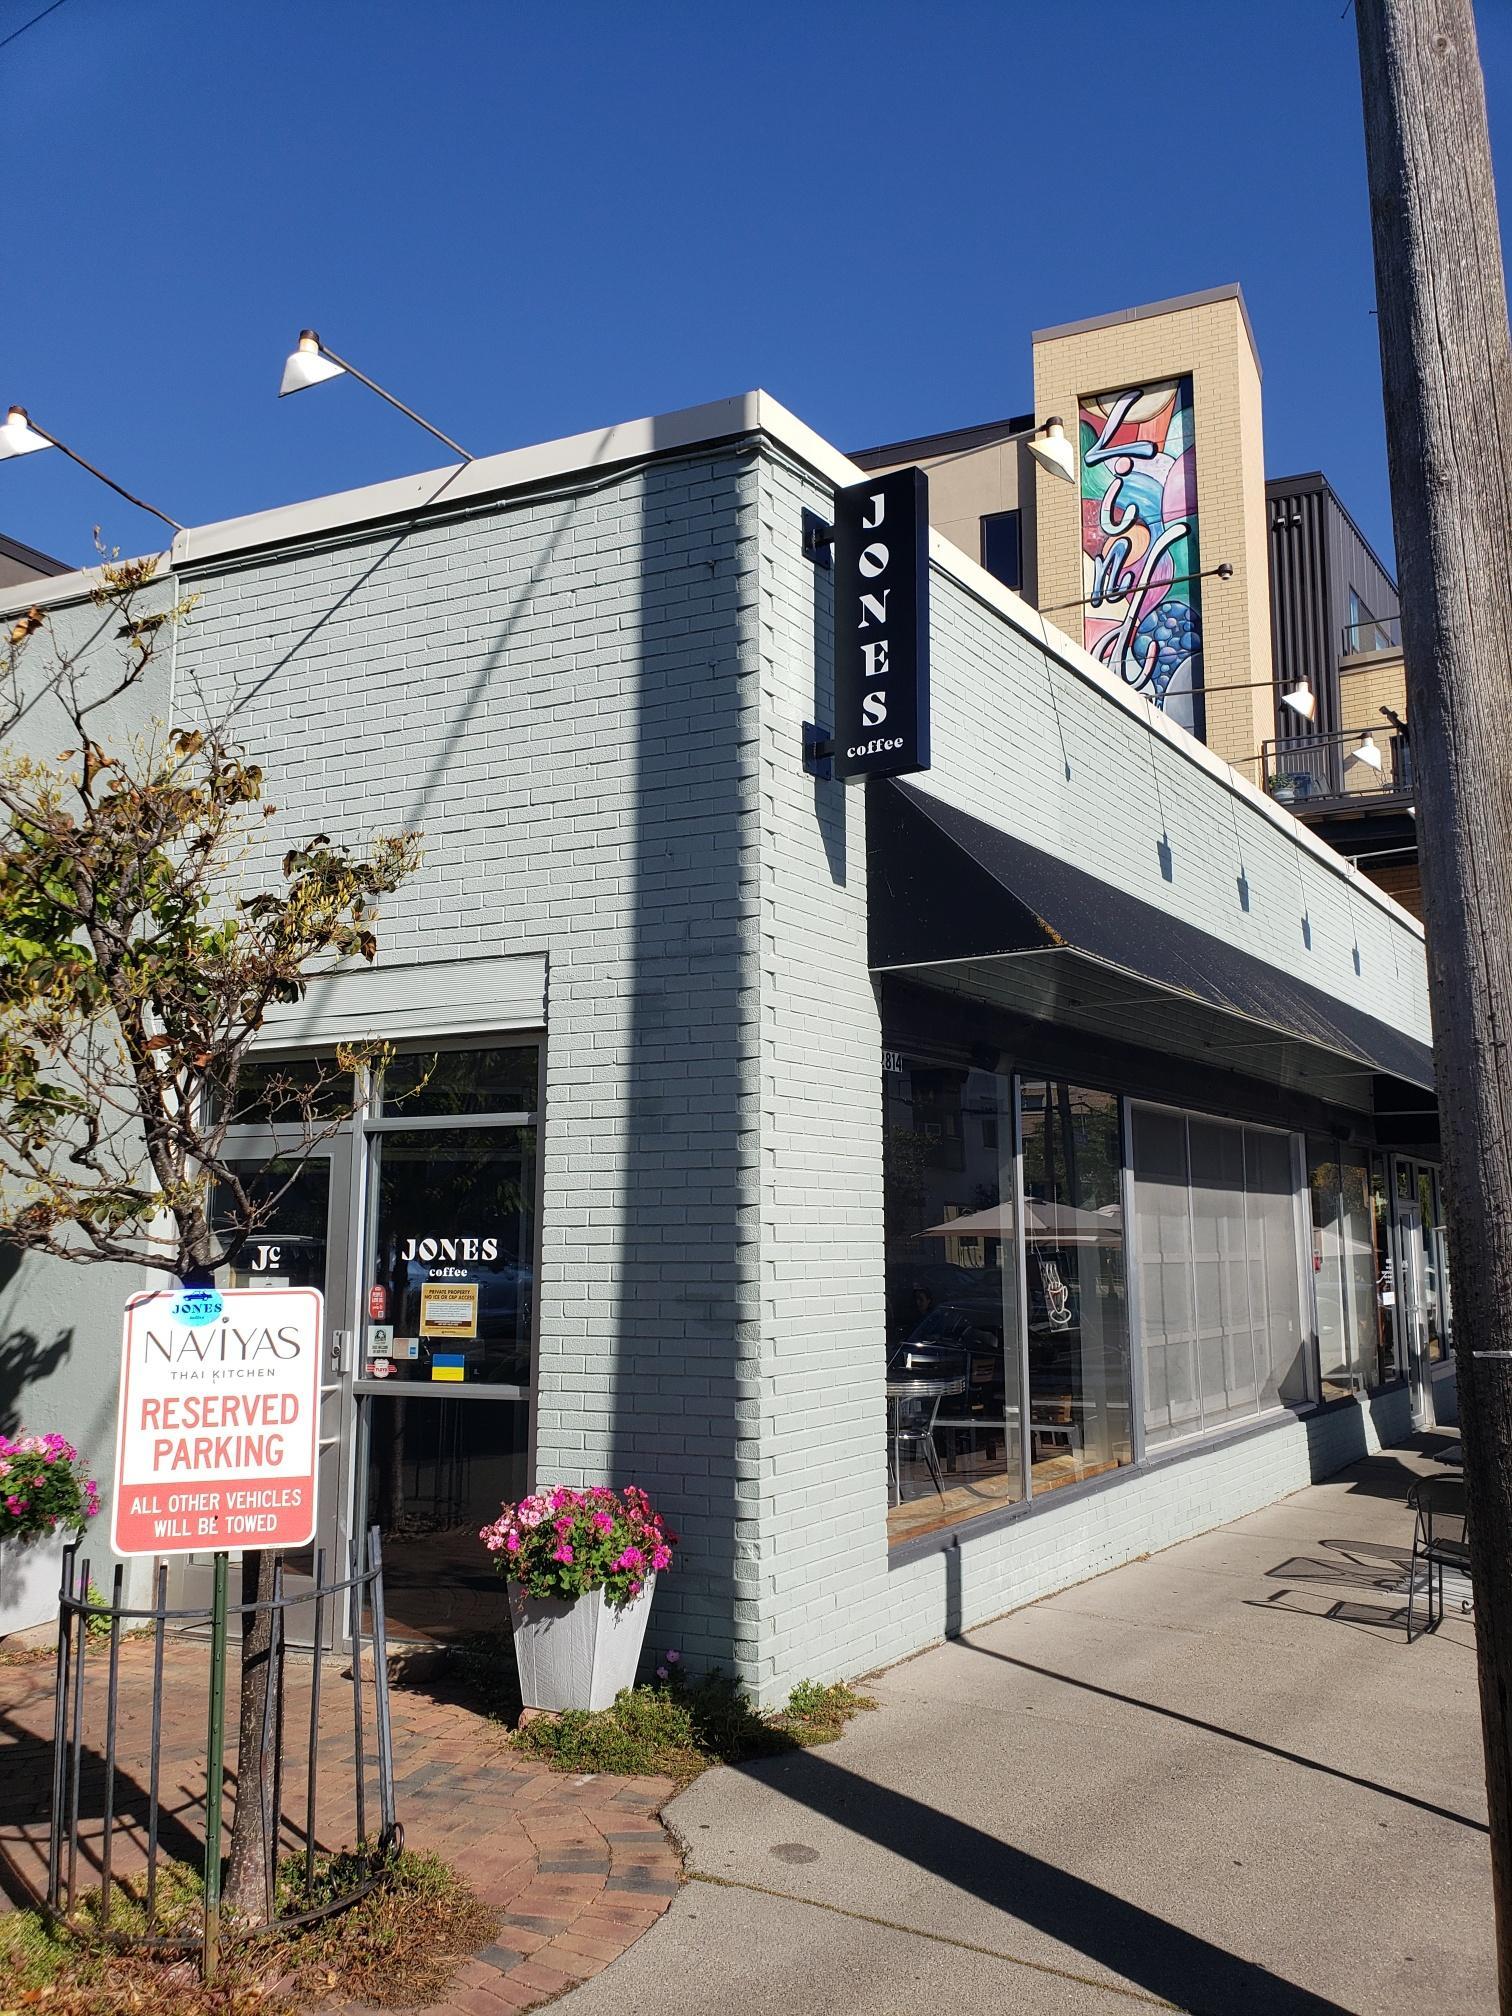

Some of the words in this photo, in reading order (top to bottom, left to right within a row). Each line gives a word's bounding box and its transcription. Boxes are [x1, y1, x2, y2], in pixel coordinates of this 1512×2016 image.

[857, 493, 891, 728] JONES
[847, 736, 904, 758] coffee
[882, 1052, 902, 1071] 814
[401, 1238, 498, 1261] JONES
[429, 1267, 468, 1277] coffee
[172, 1303, 222, 1315] JONES
[145, 1326, 301, 1363] NAVIYAS
[171, 1371, 205, 1380] THAI
[212, 1368, 276, 1379] KITCHEN
[140, 1393, 299, 1430] RESERVED
[153, 1433, 284, 1471] PARKING
[130, 1494, 161, 1515] ALL
[168, 1492, 220, 1513] OTHER
[226, 1488, 302, 1509] VEHICLES
[154, 1517, 191, 1537] WILL
[198, 1516, 217, 1536] BE
[226, 1514, 277, 1534] TOWED
